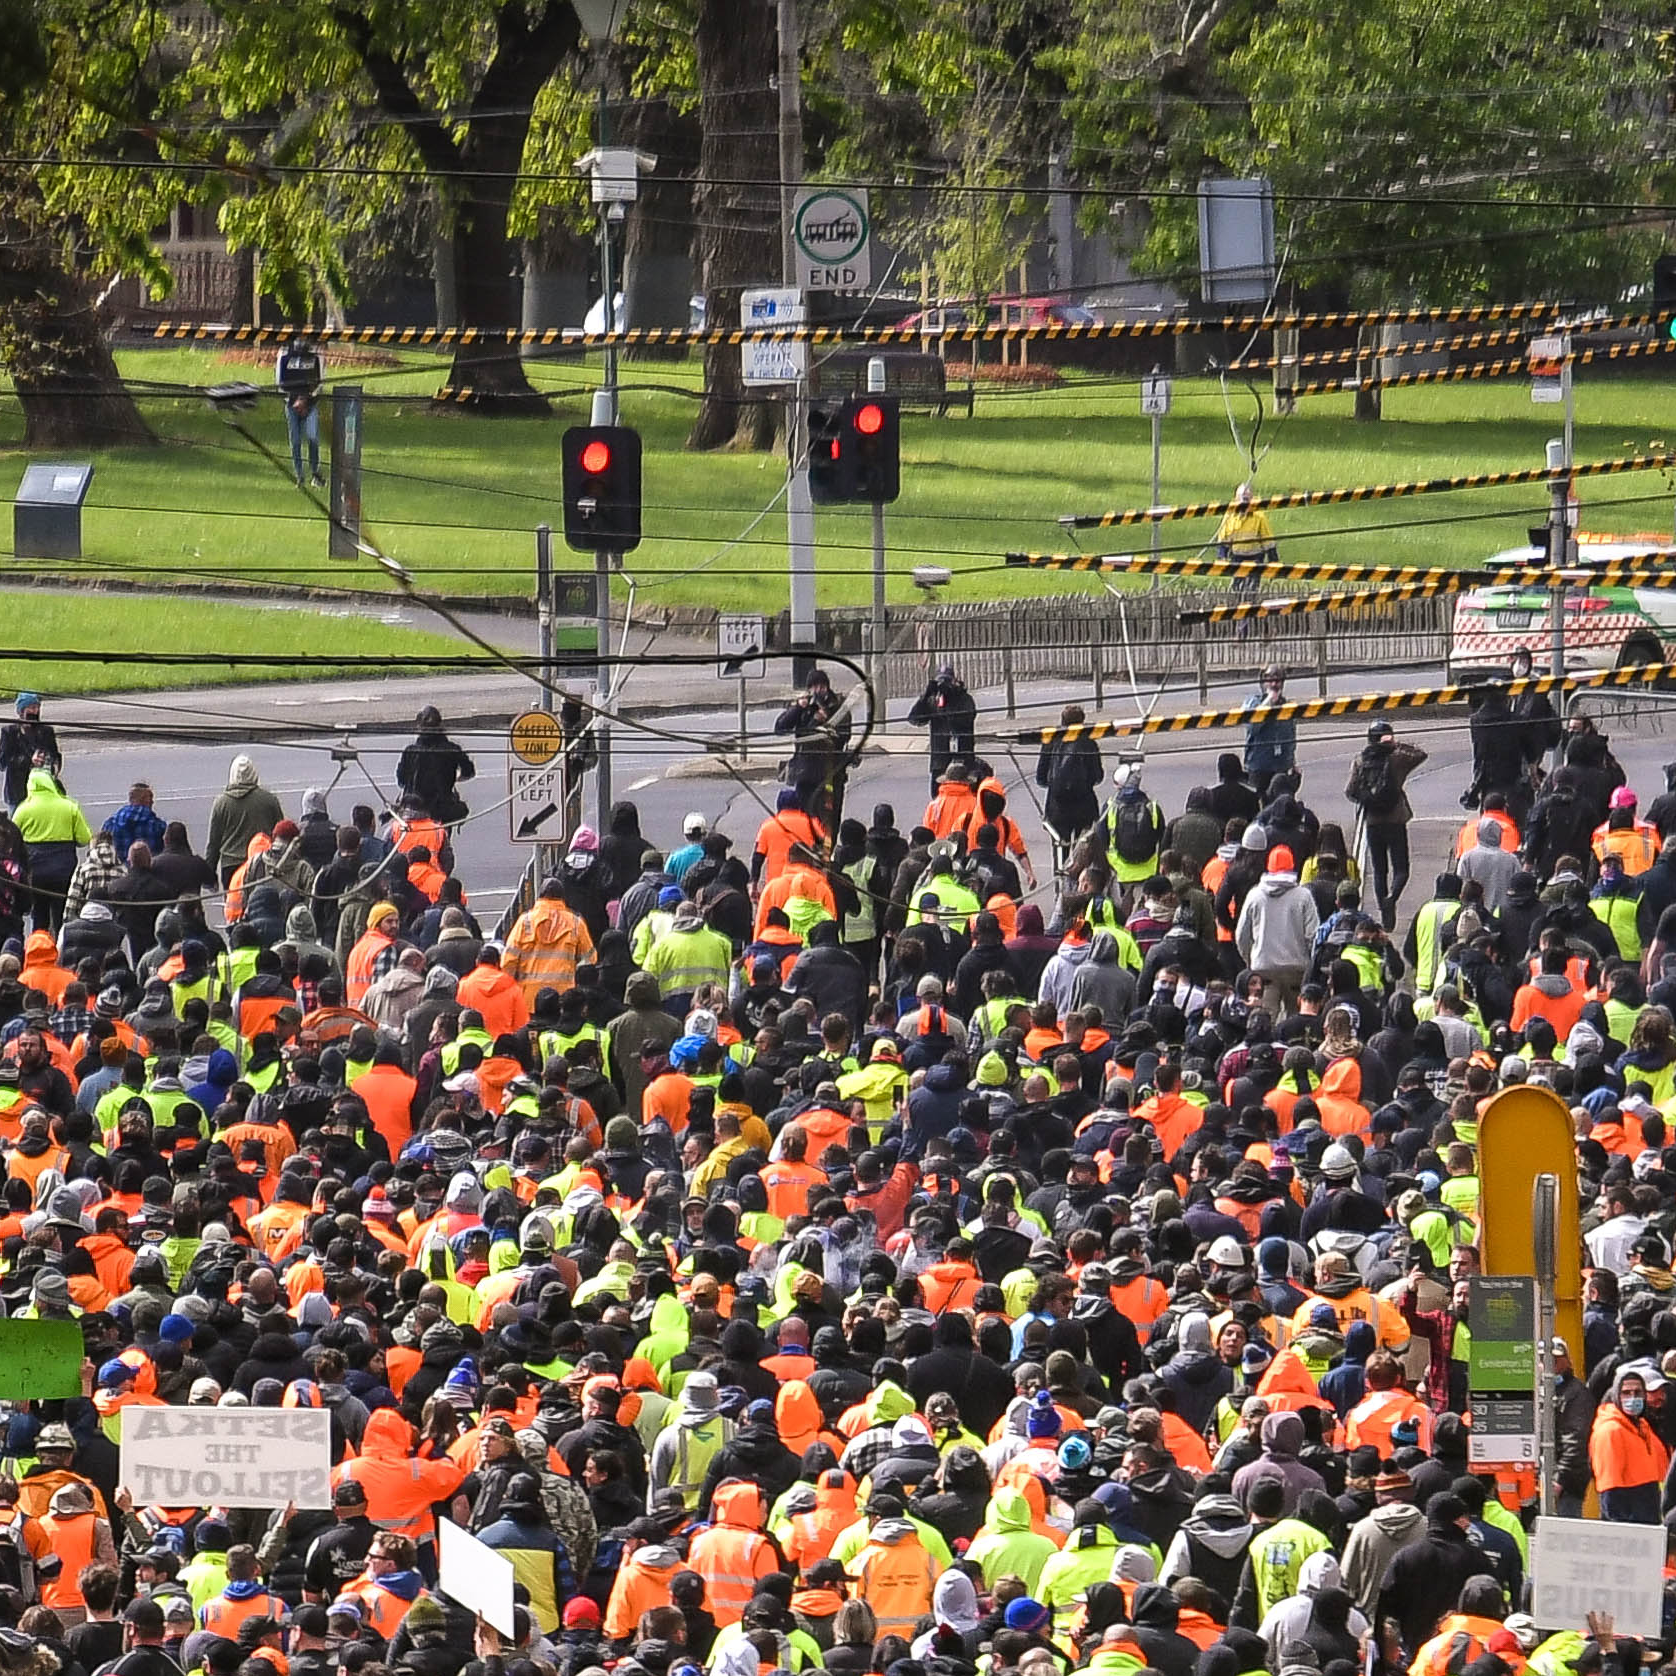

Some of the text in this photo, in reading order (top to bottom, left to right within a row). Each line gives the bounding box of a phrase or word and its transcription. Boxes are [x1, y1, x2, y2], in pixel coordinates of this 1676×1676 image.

[810, 269, 857, 286] END
[727, 620, 756, 631] KEEP
[727, 632, 755, 644] LEFT
[525, 743, 550, 757] ZONE
[518, 774, 554, 786] KEEP
[520, 789, 553, 801] LEFT
